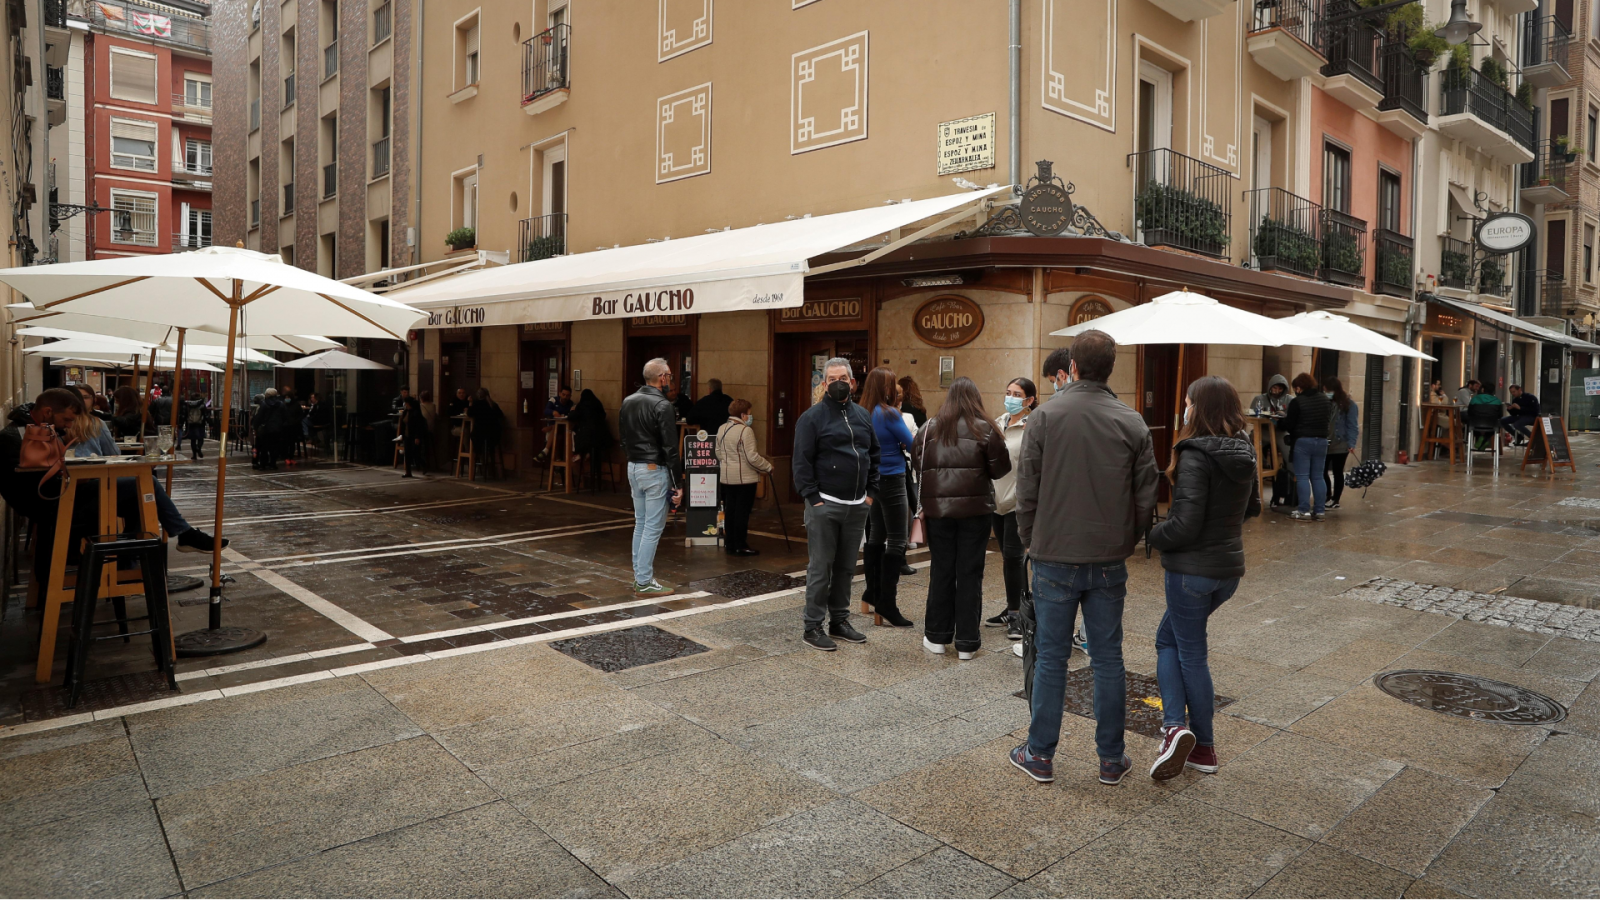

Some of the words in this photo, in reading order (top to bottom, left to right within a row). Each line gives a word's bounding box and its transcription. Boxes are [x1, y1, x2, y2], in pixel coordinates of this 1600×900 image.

[954, 125, 978, 135] TRAVESIA
[946, 137, 962, 146] ESPOZ
[972, 132, 986, 141] MINA
[944, 149, 962, 158] ESPOZ
[972, 144, 988, 152] MINA
[1487, 226, 1524, 236] EUROPA
[592, 297, 618, 316] Bar
[624, 288, 694, 313] GAUCHO
[752, 294, 770, 303] desde
[772, 293, 784, 302] 1968
[782, 308, 800, 318] Bar
[802, 300, 860, 317] GAUCHO
[428, 312, 442, 325] Bar
[446, 308, 486, 324] GAUCHO
[922, 312, 972, 329] GAUCHO
